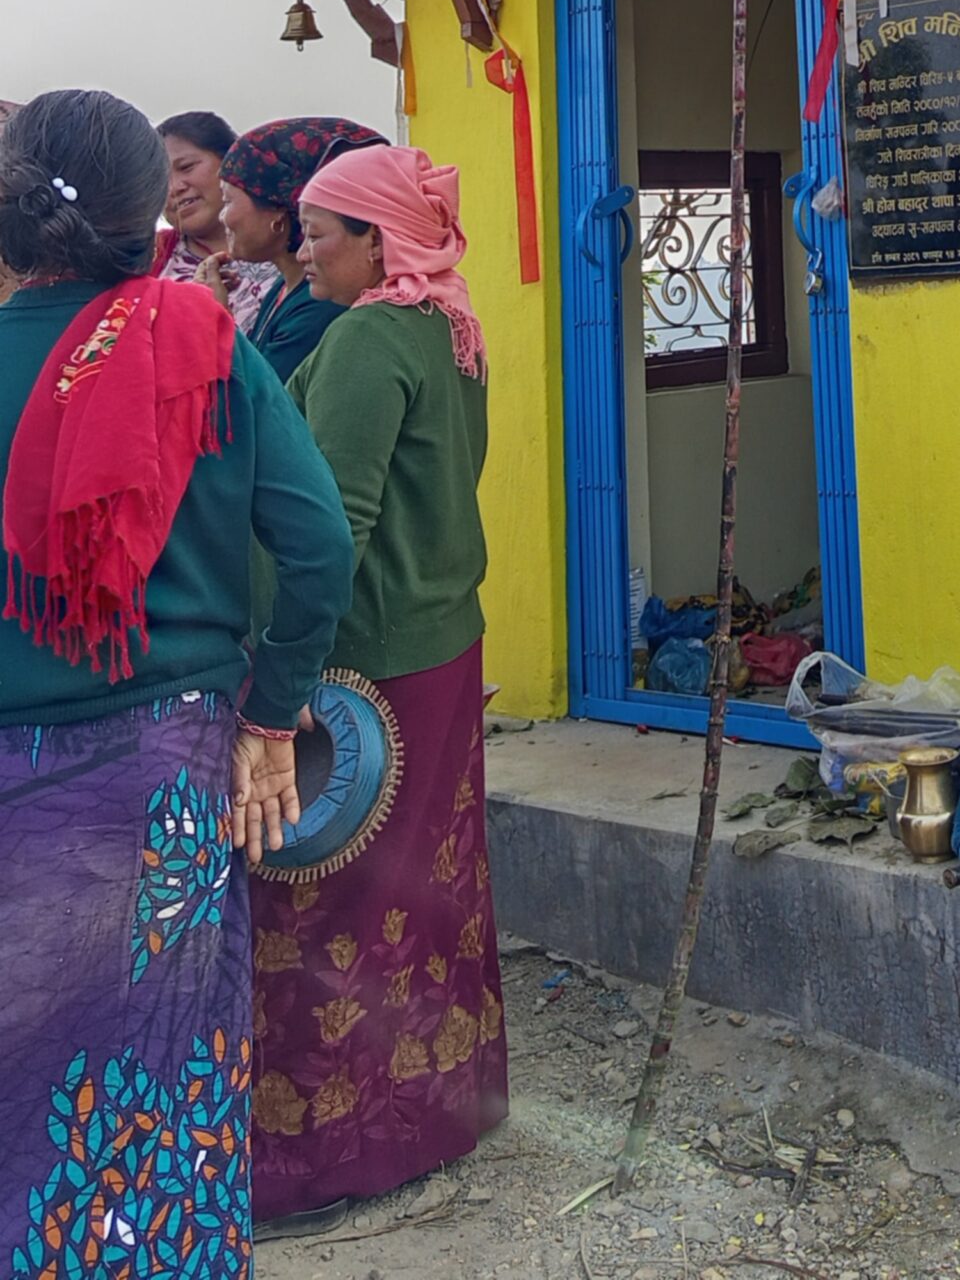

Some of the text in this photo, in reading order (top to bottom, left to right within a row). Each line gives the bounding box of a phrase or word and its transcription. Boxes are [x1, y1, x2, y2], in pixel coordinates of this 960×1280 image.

[878, 16, 917, 47] शिव
[869, 78, 886, 93] शिव
[889, 75, 917, 91] मन्दिर
[891, 98, 911, 115] मिति
[862, 197, 874, 214] श्री
[876, 196, 896, 213] होम
[898, 195, 930, 213] बहादुर
[931, 194, 954, 208] थापा
